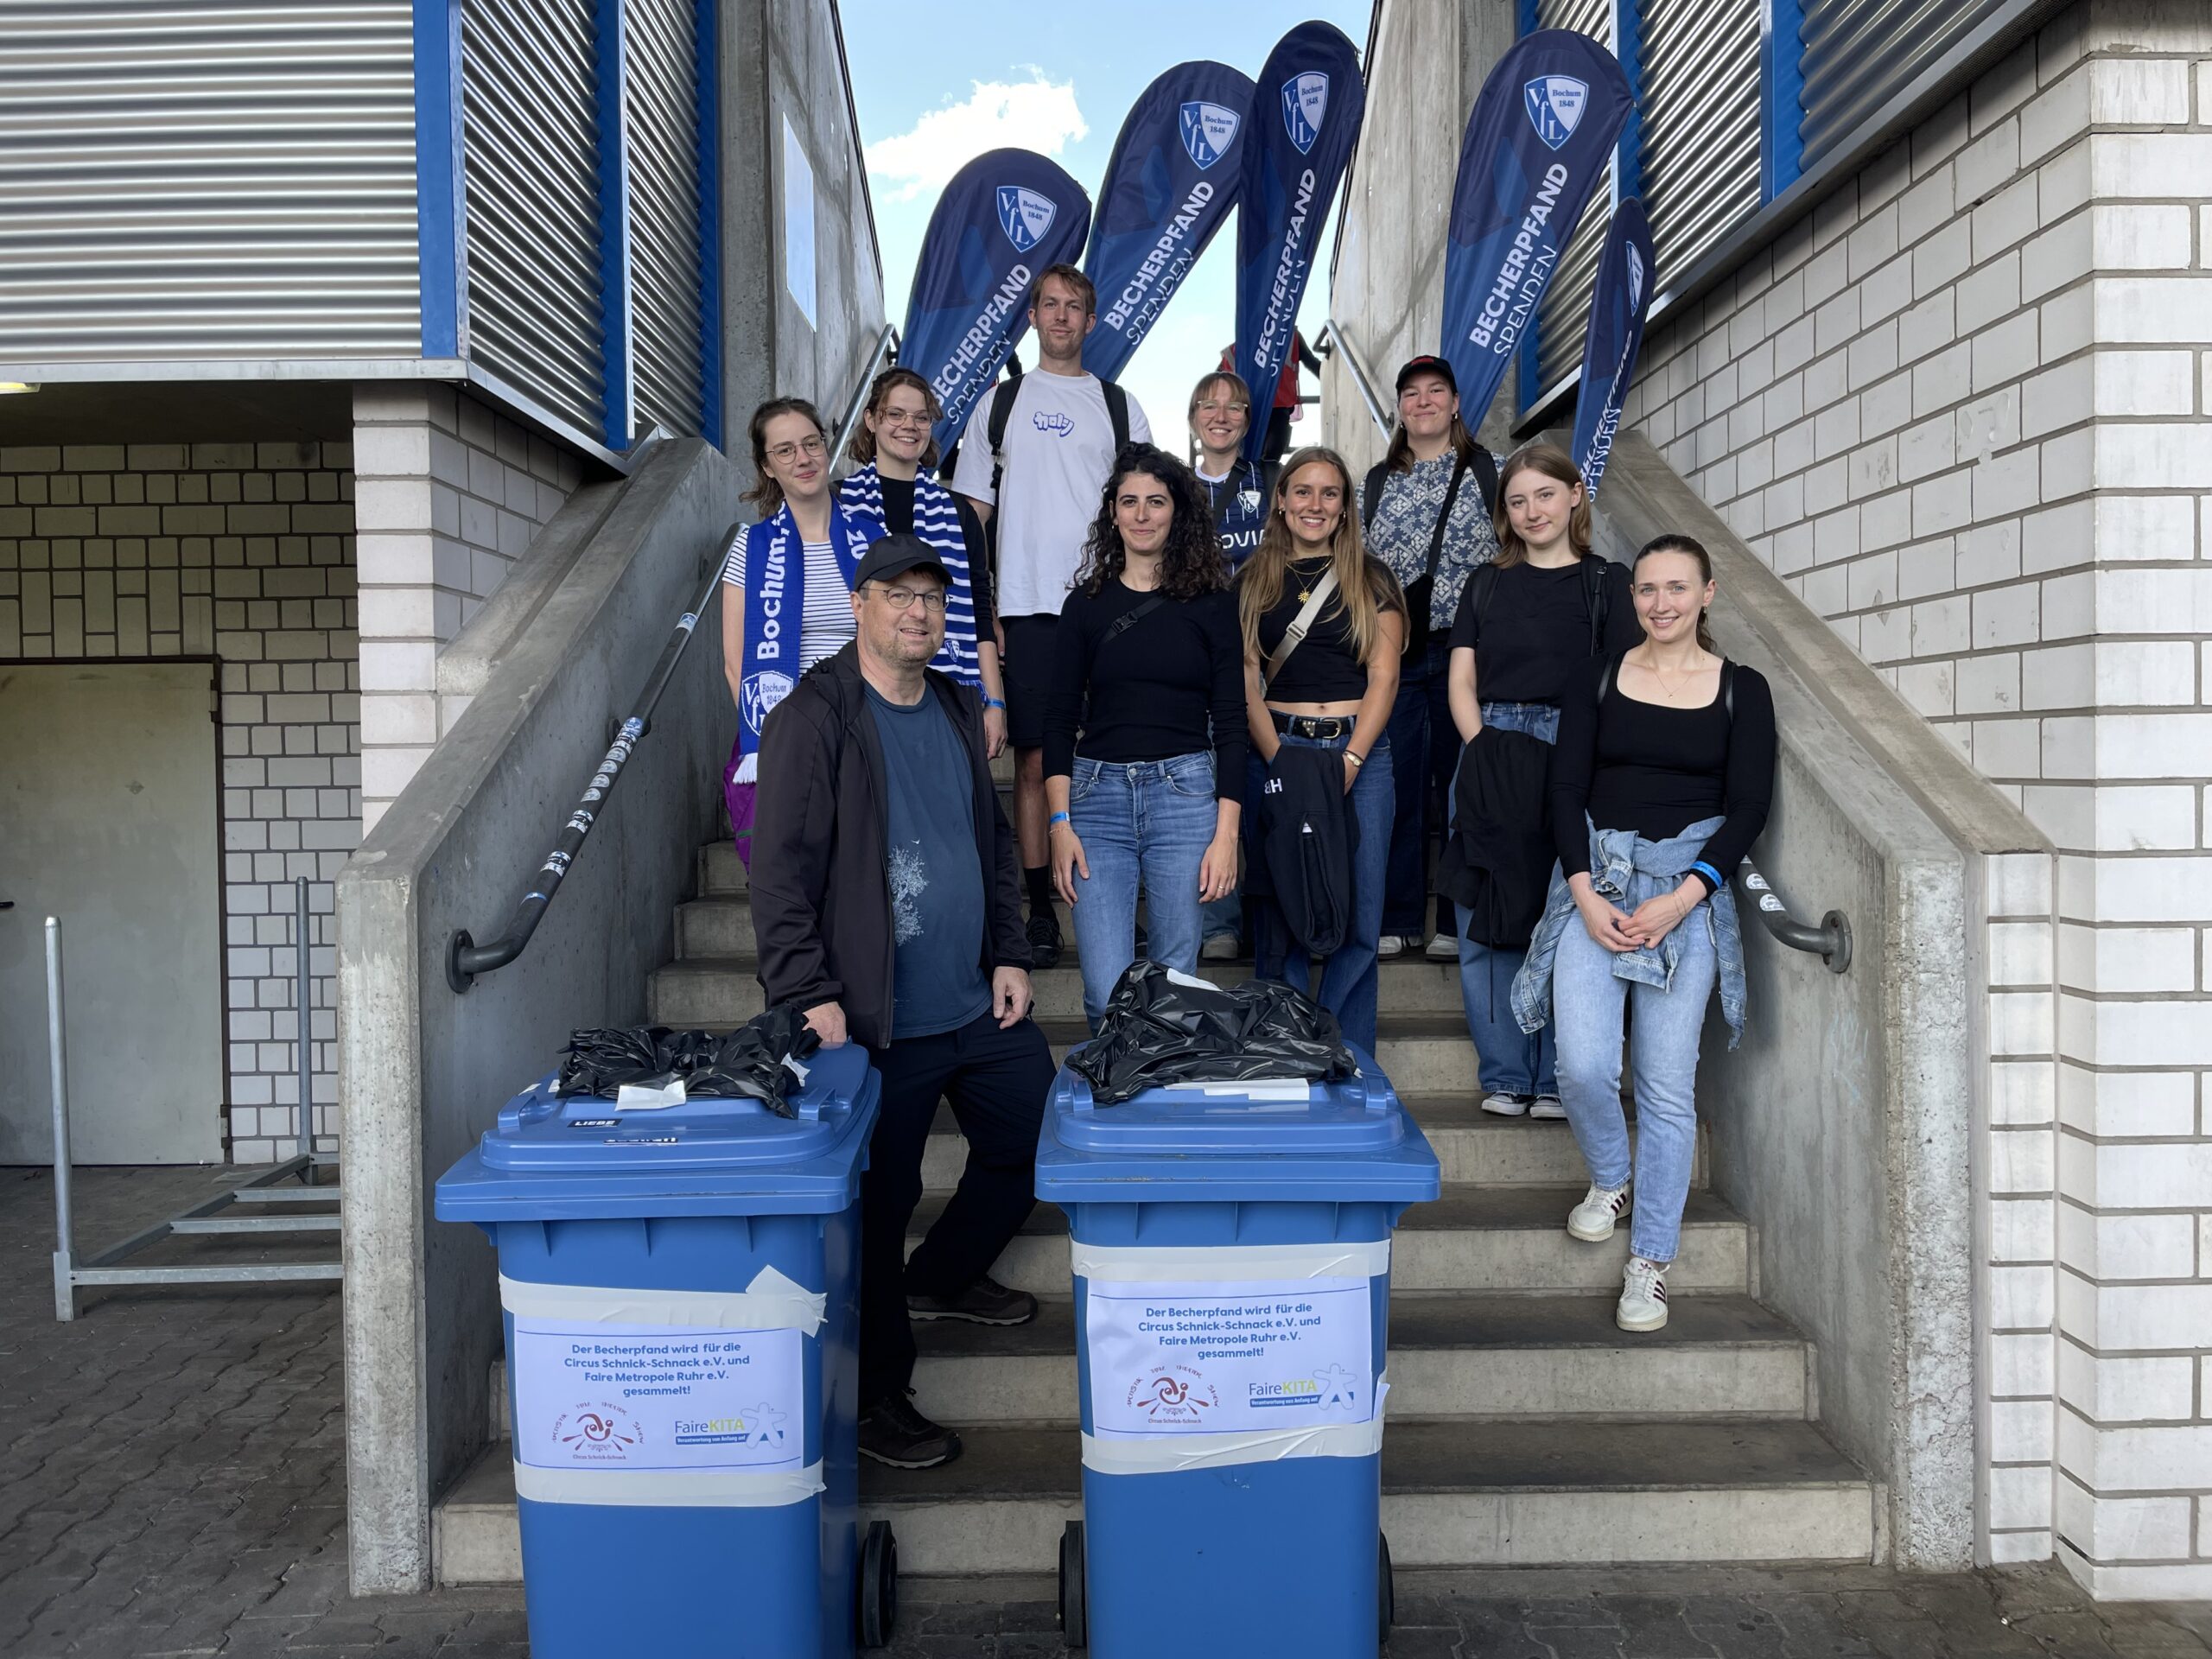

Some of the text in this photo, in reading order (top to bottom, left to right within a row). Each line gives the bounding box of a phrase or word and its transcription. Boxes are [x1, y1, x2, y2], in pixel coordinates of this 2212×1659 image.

[1301, 85, 1324, 96] Bochum
[1306, 97, 1319, 107] 1848
[1205, 115, 1233, 125] Bochum
[1284, 89, 1311, 143] VfL
[1528, 88, 1563, 140] VfL
[1183, 110, 1211, 162] VfL
[1022, 200, 1050, 213] Bochum
[1001, 192, 1030, 245] VfL
[1028, 211, 1043, 220] 1848
[1103, 181, 1214, 331] BECHERPFAND
[1469, 163, 1568, 348] BECHERPFAND
[1254, 168, 1316, 369] BECHERPFAND
[1126, 247, 1194, 346] SPENDEN
[1493, 245, 1557, 357] SPENDEN
[762, 683, 786, 693] Bochum
[1146, 1303, 1313, 1319] Der Becherpfand wird für die
[1138, 1316, 1321, 1332] Circus Schnick-Schnack e.V. und
[1159, 1332, 1301, 1346] Faire Metropole Ruhr e.V.
[572, 1342, 741, 1357] Der Becherpfand wird für die
[1198, 1347, 1264, 1360] gesammelt!
[564, 1355, 750, 1368] Circus Schnick-Schnack e.V. und
[584, 1370, 729, 1383] Faire Metropole Ruhr e.V.
[623, 1385, 690, 1397] gesammelt!
[1249, 1380, 1318, 1395] FaireKITA
[675, 1418, 746, 1433] FaireKITA
